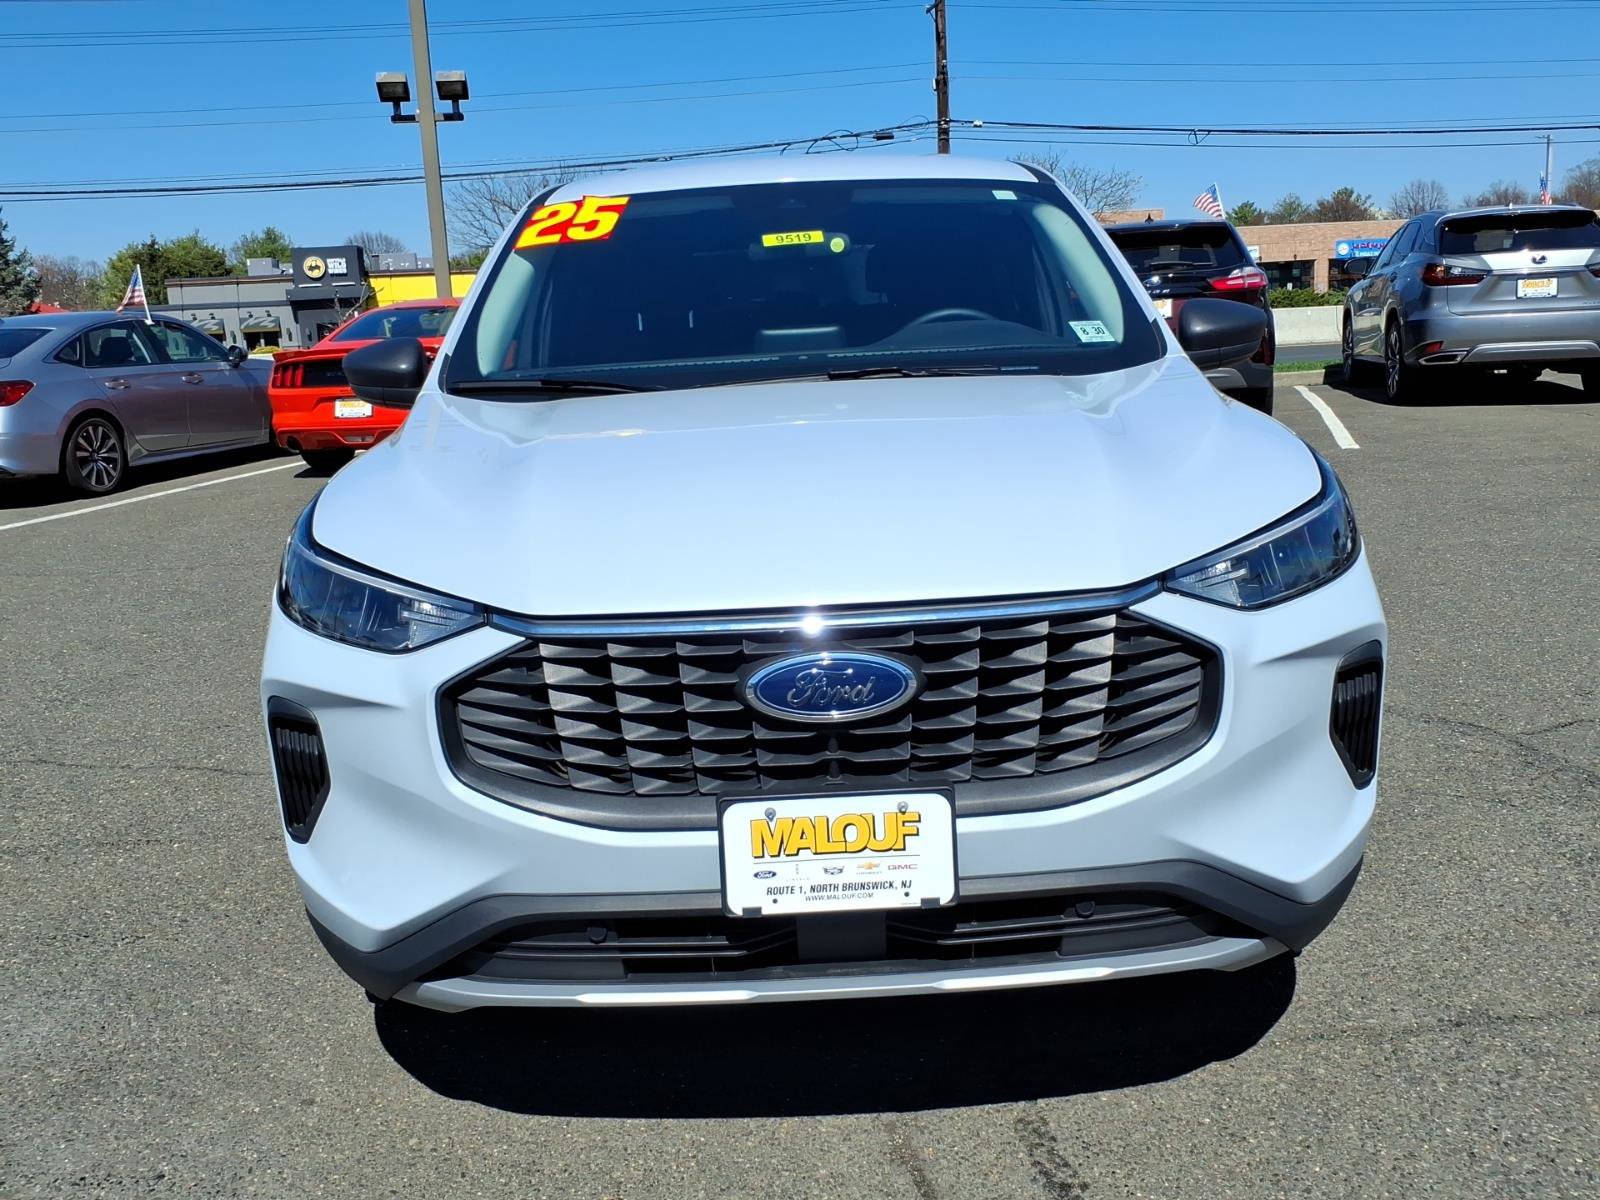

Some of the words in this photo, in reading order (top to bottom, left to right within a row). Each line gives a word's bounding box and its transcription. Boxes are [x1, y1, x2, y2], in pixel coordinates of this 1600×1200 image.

[515, 196, 630, 249] 25
[776, 233, 811, 244] 9519
[1080, 327, 1089, 335] 8
[1091, 326, 1105, 334] 30
[787, 668, 875, 706] Ford
[751, 812, 921, 858] MALOUF
[887, 863, 918, 871] GMC
[766, 885, 796, 896] ROUTE
[799, 886, 807, 895] 1,
[809, 883, 839, 894] NORTH
[842, 880, 898, 892] BRUNSWICK,
[900, 880, 912, 889] NJ
[805, 892, 874, 902] WWW.MALOUF.COM
